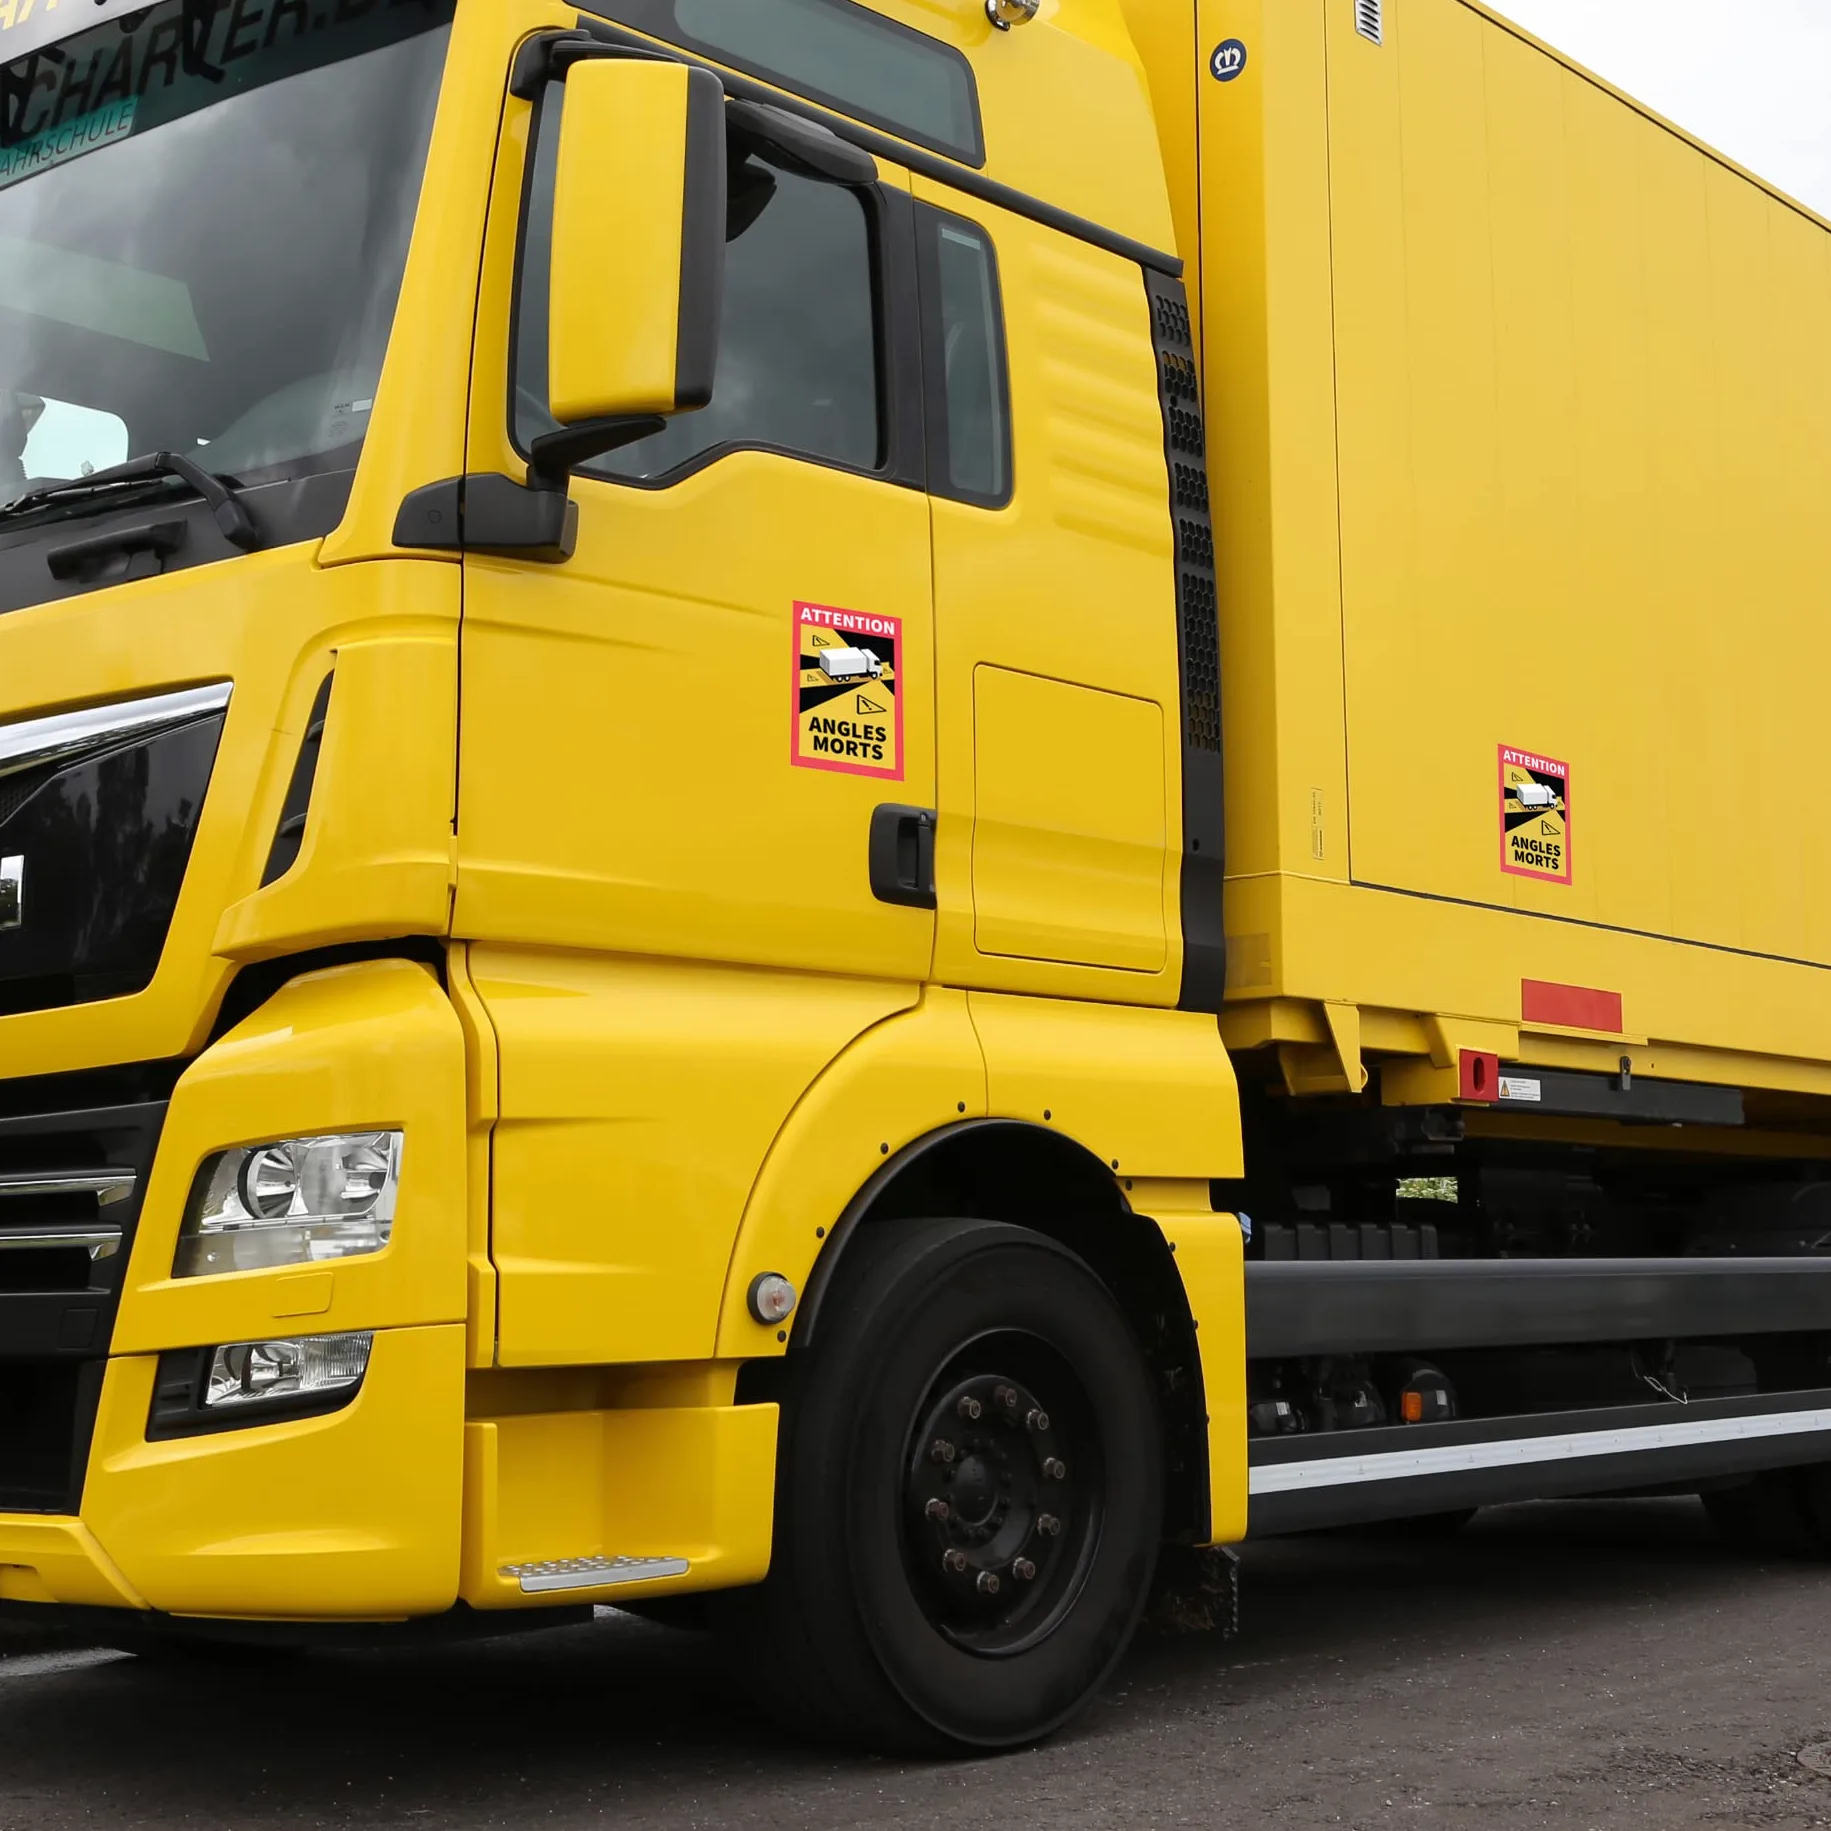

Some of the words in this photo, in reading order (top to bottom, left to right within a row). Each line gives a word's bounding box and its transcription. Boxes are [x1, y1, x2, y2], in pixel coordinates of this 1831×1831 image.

[801, 607, 895, 636] ATTENTION
[809, 716, 887, 743] ANGLES
[813, 735, 883, 760] MORTS
[1503, 750, 1565, 776] ATTENTION
[1511, 835, 1561, 857] ANGLES
[1514, 849, 1559, 870] MORTS
